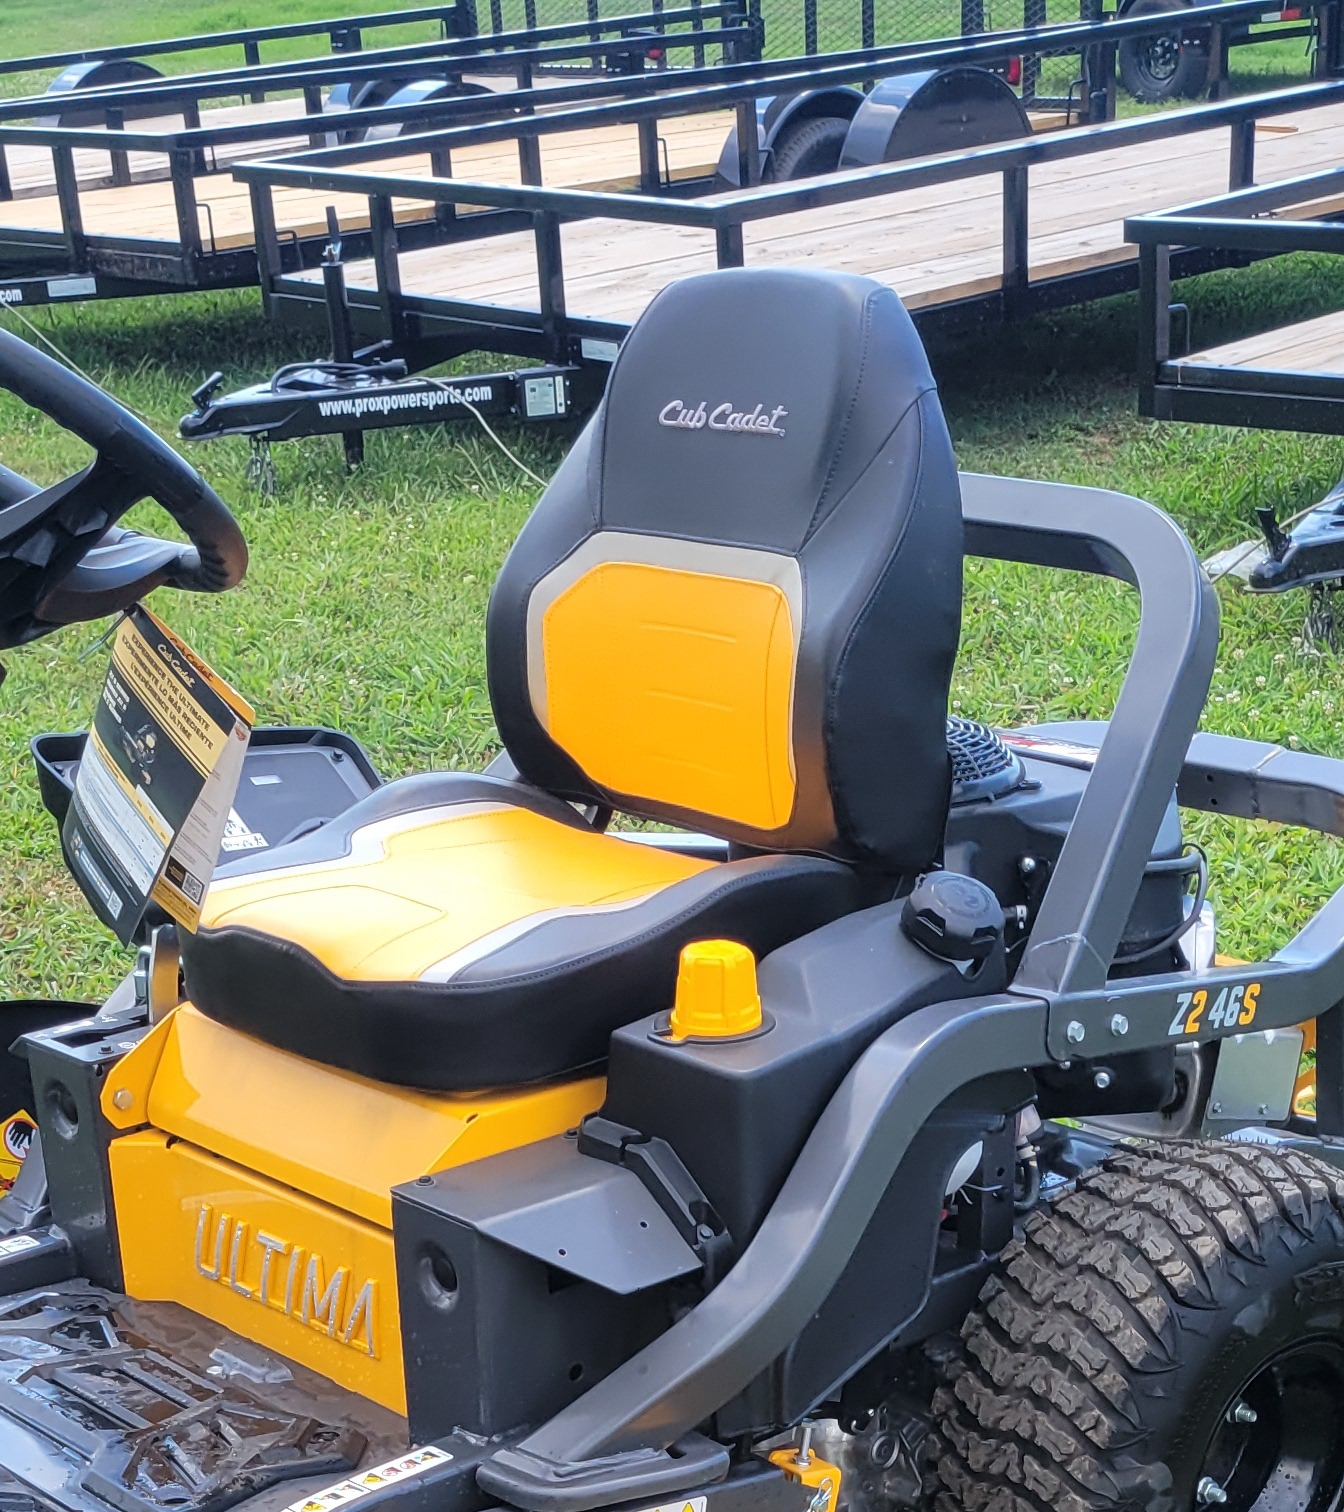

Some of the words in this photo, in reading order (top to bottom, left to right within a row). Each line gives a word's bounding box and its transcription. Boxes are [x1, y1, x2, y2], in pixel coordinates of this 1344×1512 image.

[318, 384, 493, 417] www.proxpowersports.com
[658, 400, 707, 429] Cub
[708, 403, 788, 435] Cadet
[131, 634, 167, 681] EXPERIENCE
[166, 677, 180, 695] THE
[178, 690, 211, 731] ULTIMATE
[158, 644, 174, 663] Cub
[170, 659, 196, 689] Cadet
[159, 683, 168, 697] LO
[181, 711, 214, 751] RECIENTE
[169, 710, 193, 742] ULTIME
[1168, 990, 1208, 1036] Z2
[1208, 983, 1261, 1029] 46S
[195, 1203, 378, 1358] ULTIMA
